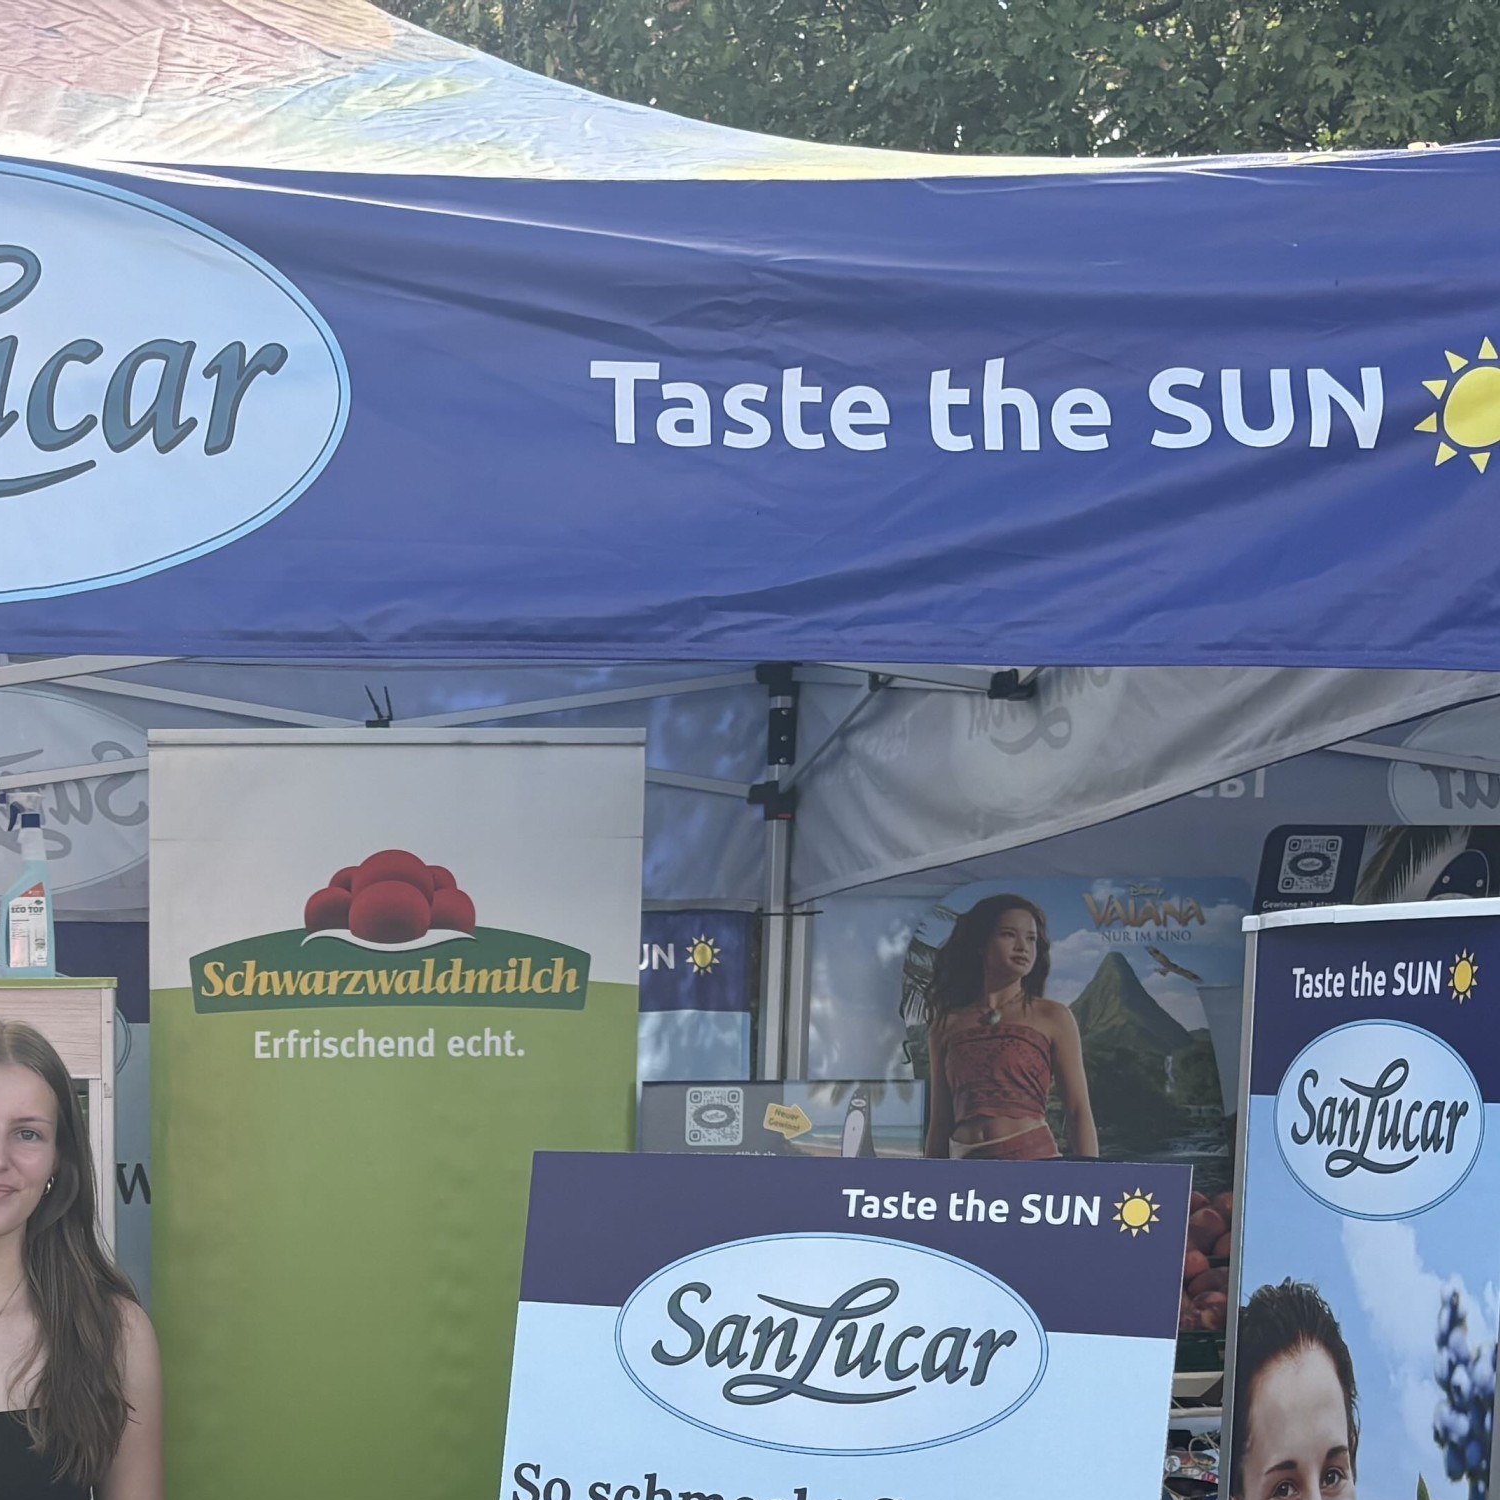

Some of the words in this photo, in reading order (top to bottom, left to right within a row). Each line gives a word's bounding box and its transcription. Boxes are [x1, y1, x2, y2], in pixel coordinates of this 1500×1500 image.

[590, 360, 889, 451] Taste
[930, 357, 1111, 451] the
[1148, 365, 1384, 449] SUN
[1082, 891, 1206, 929] VAIANA
[1101, 930, 1130, 942] NUR
[1135, 930, 1151, 942] IM
[1156, 930, 1192, 942] KINO
[200, 956, 581, 998] Schwarzwaldmilch
[1292, 966, 1344, 999] Taste
[1350, 960, 1387, 998] the
[1392, 960, 1442, 996] SUN
[253, 1028, 435, 1060] Erfrischend
[447, 1028, 526, 1058] echt.
[1291, 1057, 1469, 1179] SanLucar
[843, 1188, 937, 1220] Taste
[949, 1190, 1009, 1224] the
[1019, 1192, 1101, 1226] SUN
[650, 1277, 1017, 1405] SanLucar
